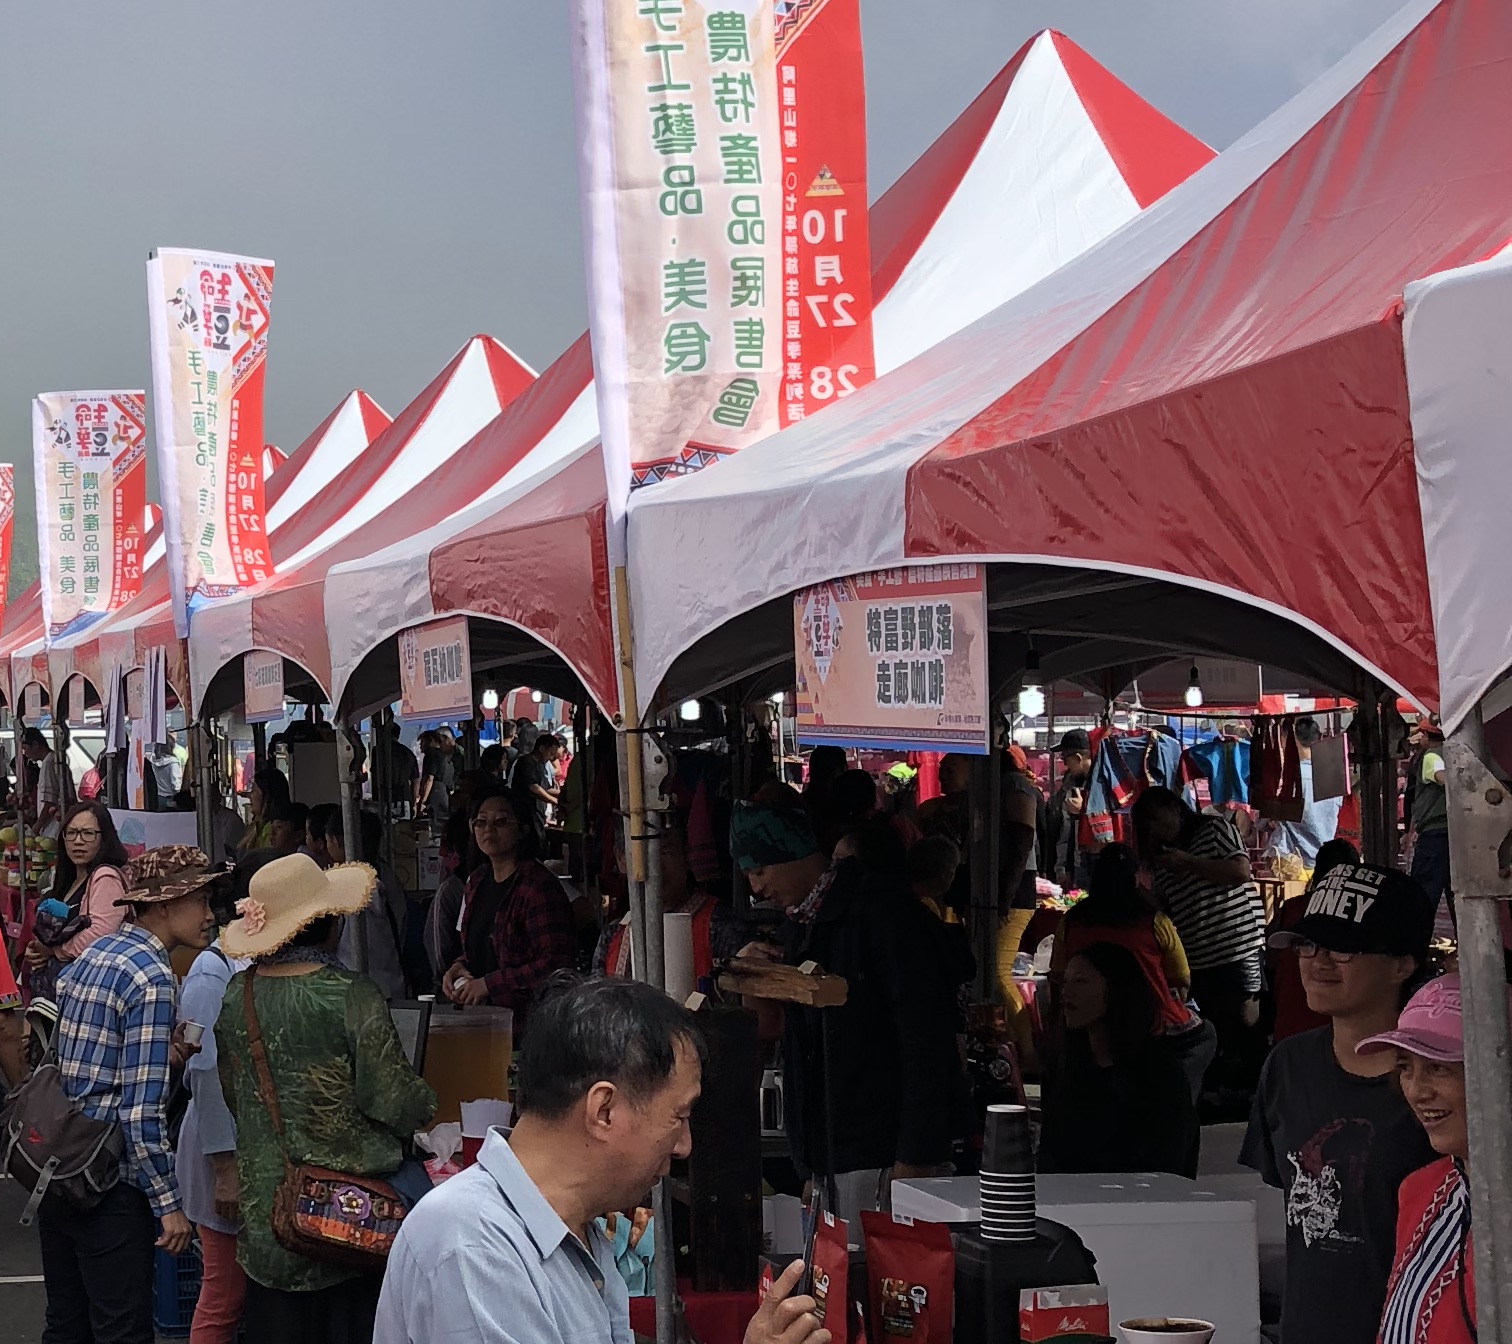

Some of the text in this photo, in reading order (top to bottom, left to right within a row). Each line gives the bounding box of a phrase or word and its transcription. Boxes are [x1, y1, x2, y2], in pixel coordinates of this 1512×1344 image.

[866, 603, 953, 654] 特富野部落
[876, 659, 945, 705] 走廊咖啡
[1325, 876, 1347, 890] THE
[1355, 867, 1387, 886] GET
